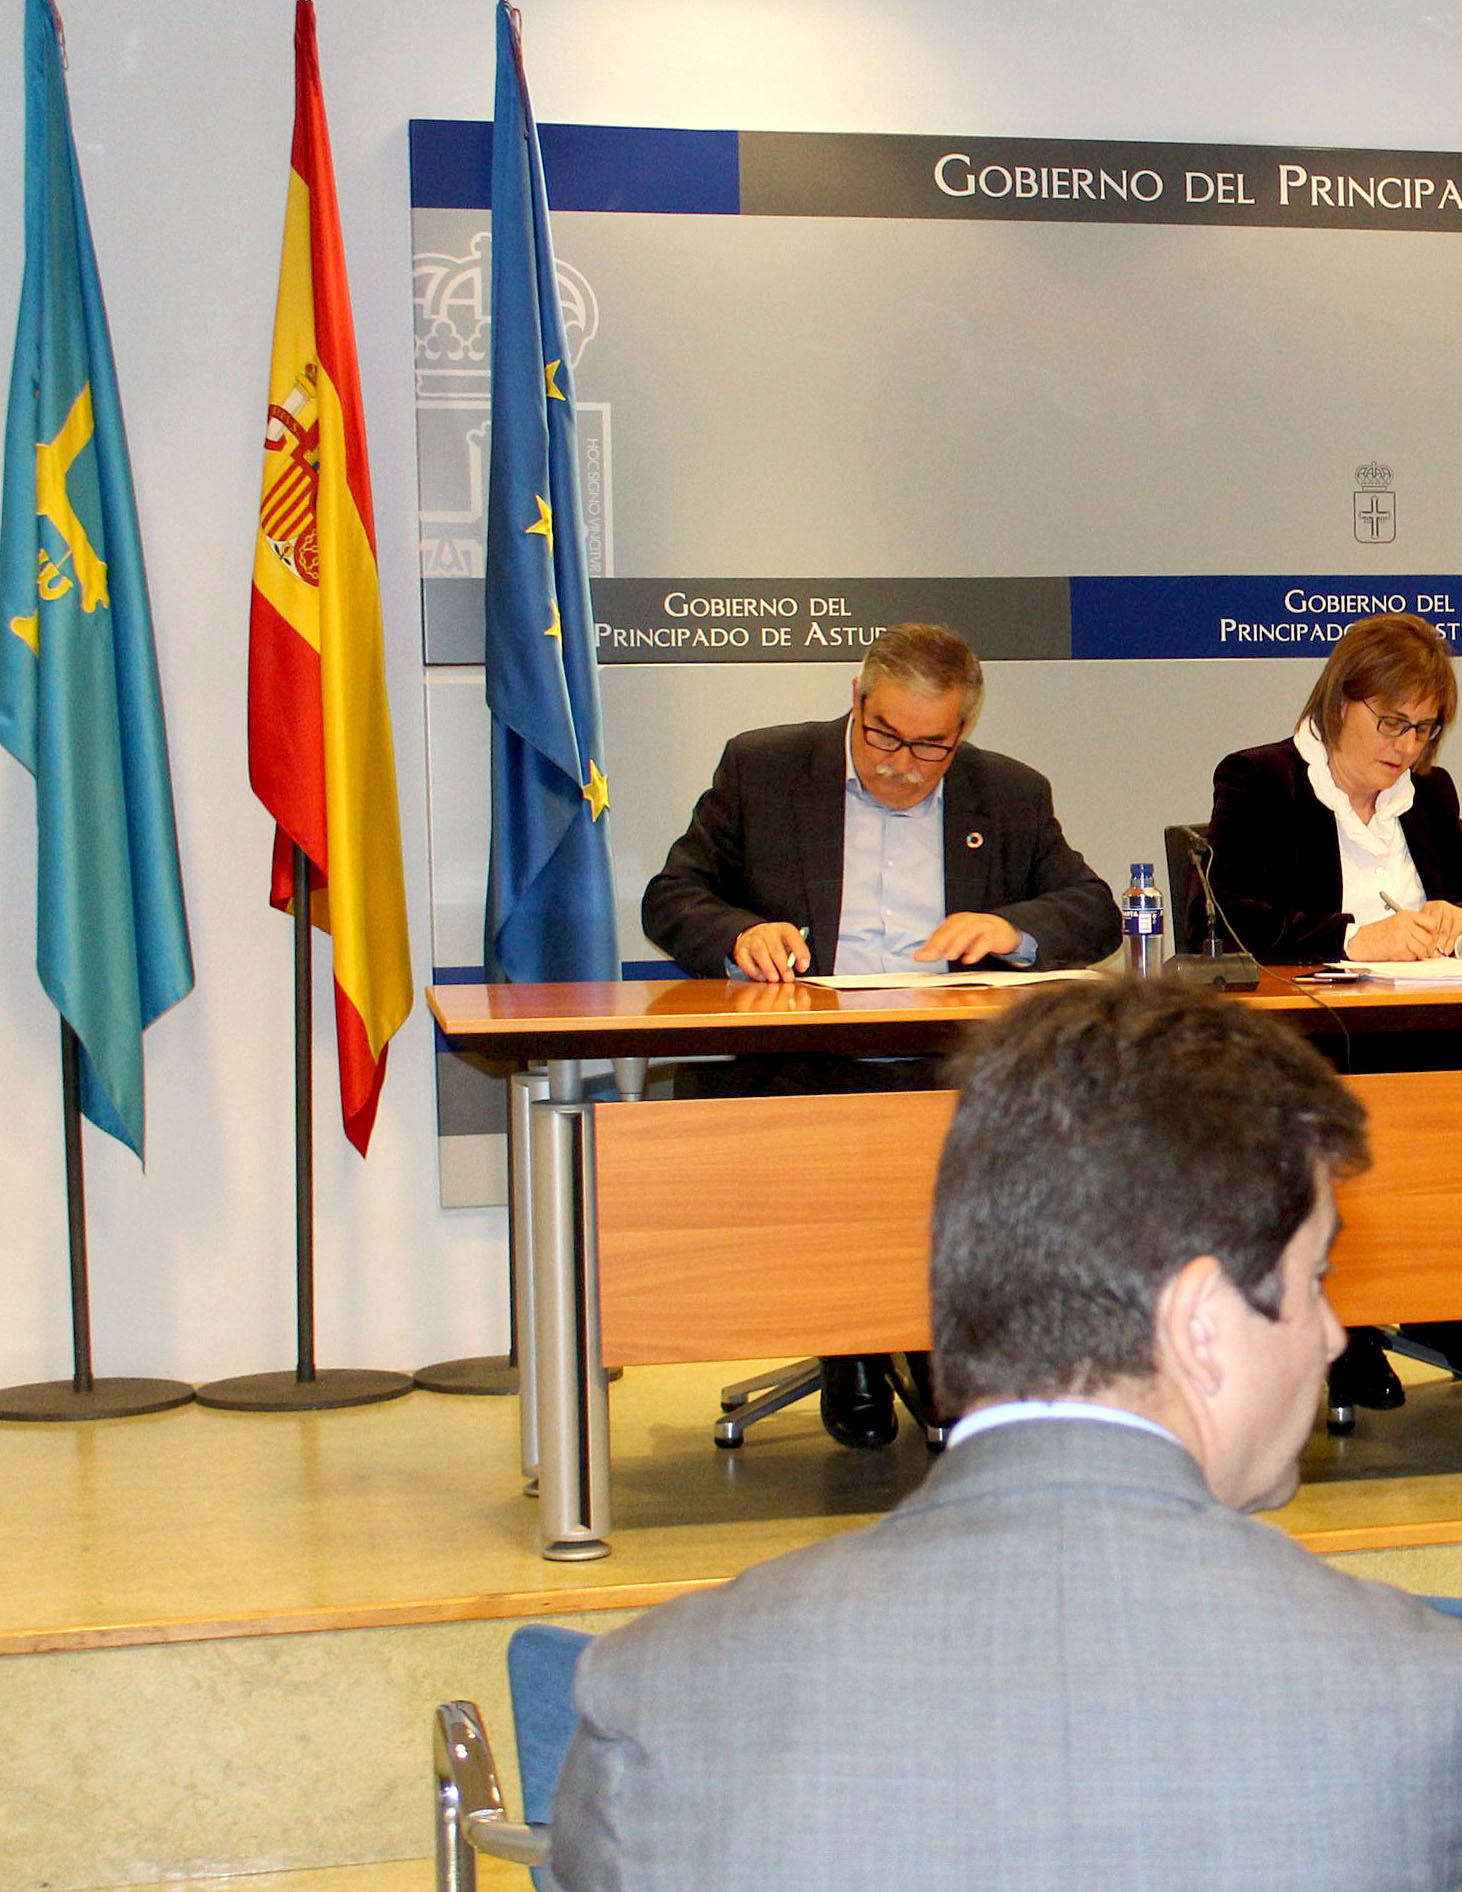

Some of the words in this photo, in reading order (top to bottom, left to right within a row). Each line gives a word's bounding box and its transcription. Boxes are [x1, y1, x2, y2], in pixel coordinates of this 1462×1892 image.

[934, 152, 1164, 203] GOBIERNO
[1185, 171, 1256, 205] DEL
[586, 437, 601, 470] HOC
[587, 471, 601, 515] SIGNO
[663, 592, 798, 617] GOBIERNO
[810, 597, 852, 617] DEL
[1284, 589, 1406, 613] GOBIERNO
[1417, 594, 1455, 613] DEL
[595, 623, 750, 647] PRINCIPADO
[761, 627, 792, 647] DE
[804, 621, 887, 646] ASTU
